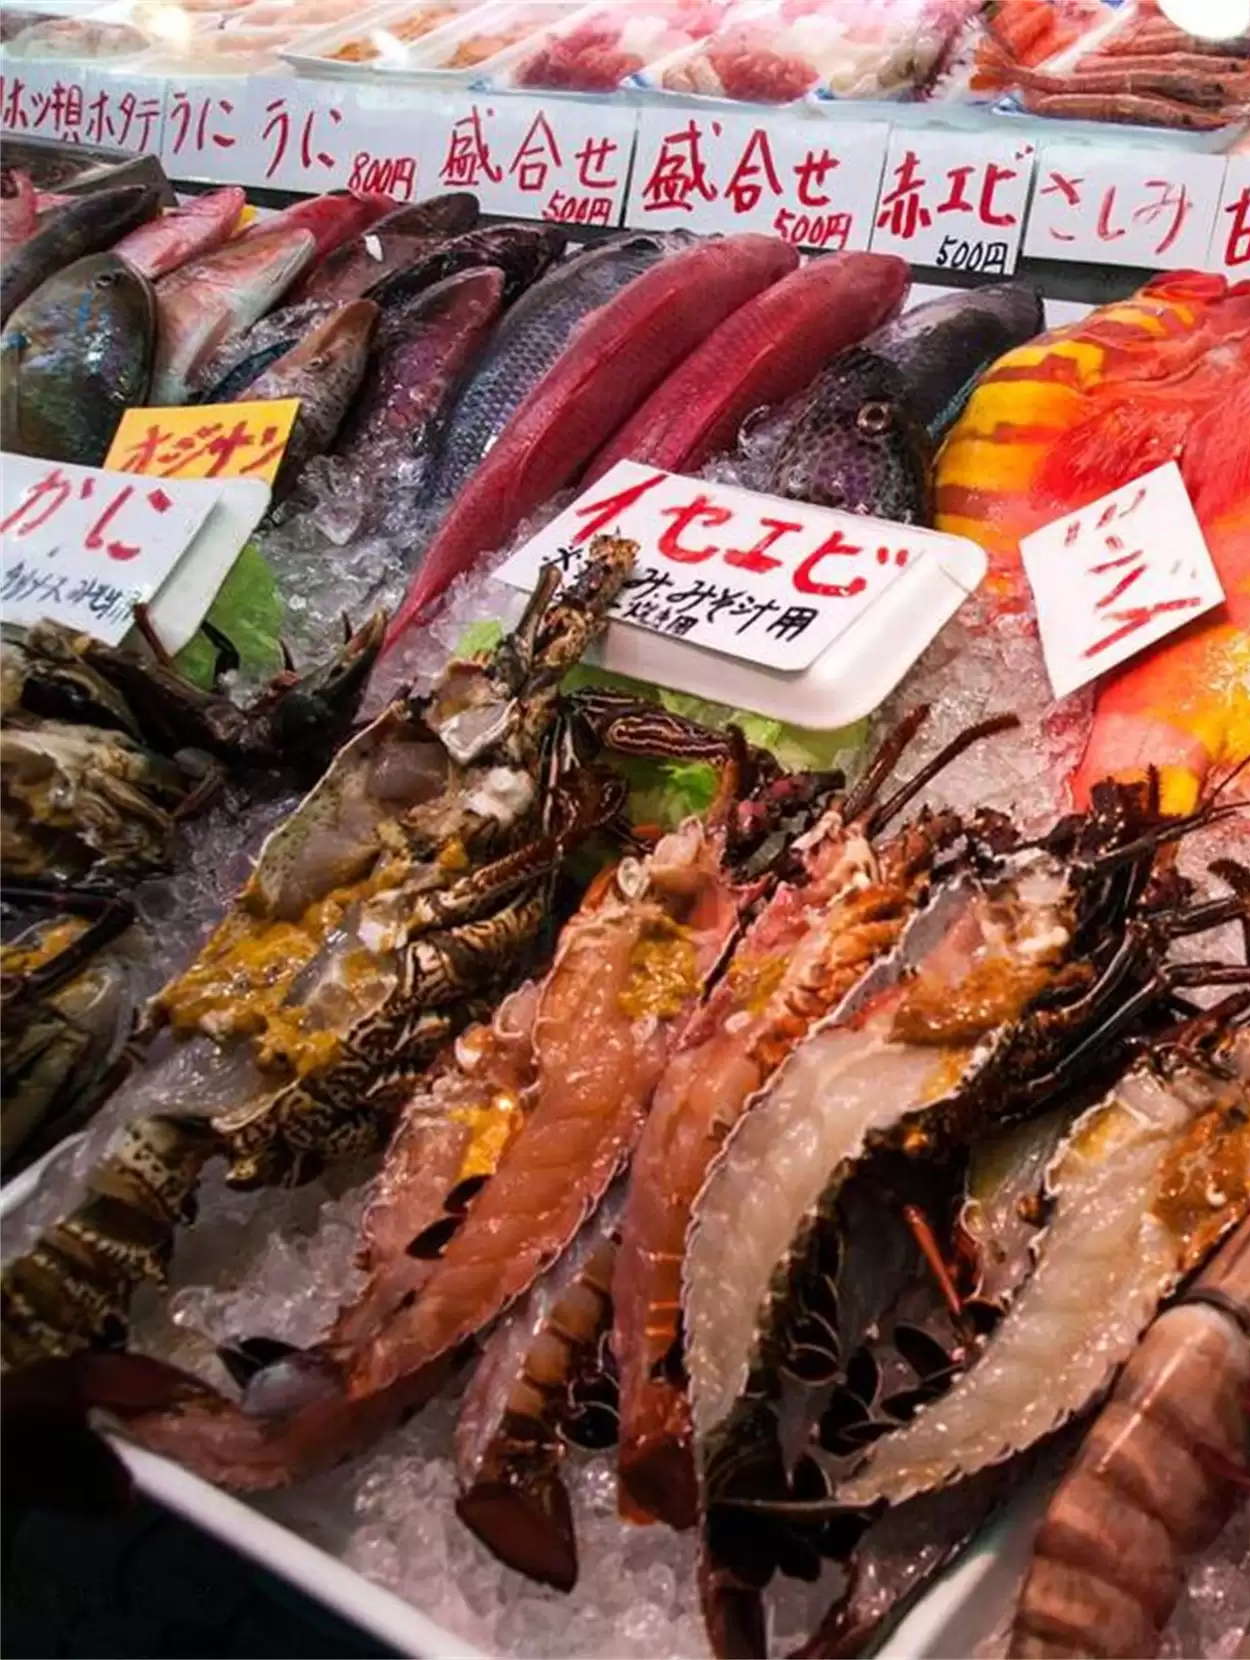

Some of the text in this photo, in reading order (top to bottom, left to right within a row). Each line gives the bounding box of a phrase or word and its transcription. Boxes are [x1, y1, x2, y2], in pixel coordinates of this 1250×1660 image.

[85, 89, 160, 152] ホタテ
[171, 92, 235, 154] うに
[262, 99, 342, 179] うに
[439, 105, 618, 192] 盛合せ
[347, 152, 416, 200] 800円
[641, 119, 841, 213] 盛合せ
[876, 144, 1034, 241] 赤エビ
[542, 190, 613, 228] 500円
[773, 207, 853, 250] 500円
[1041, 170, 1193, 255] さしみ
[937, 234, 1008, 274] 500円
[0, 468, 173, 561] かに
[570, 473, 909, 598] イセエビ
